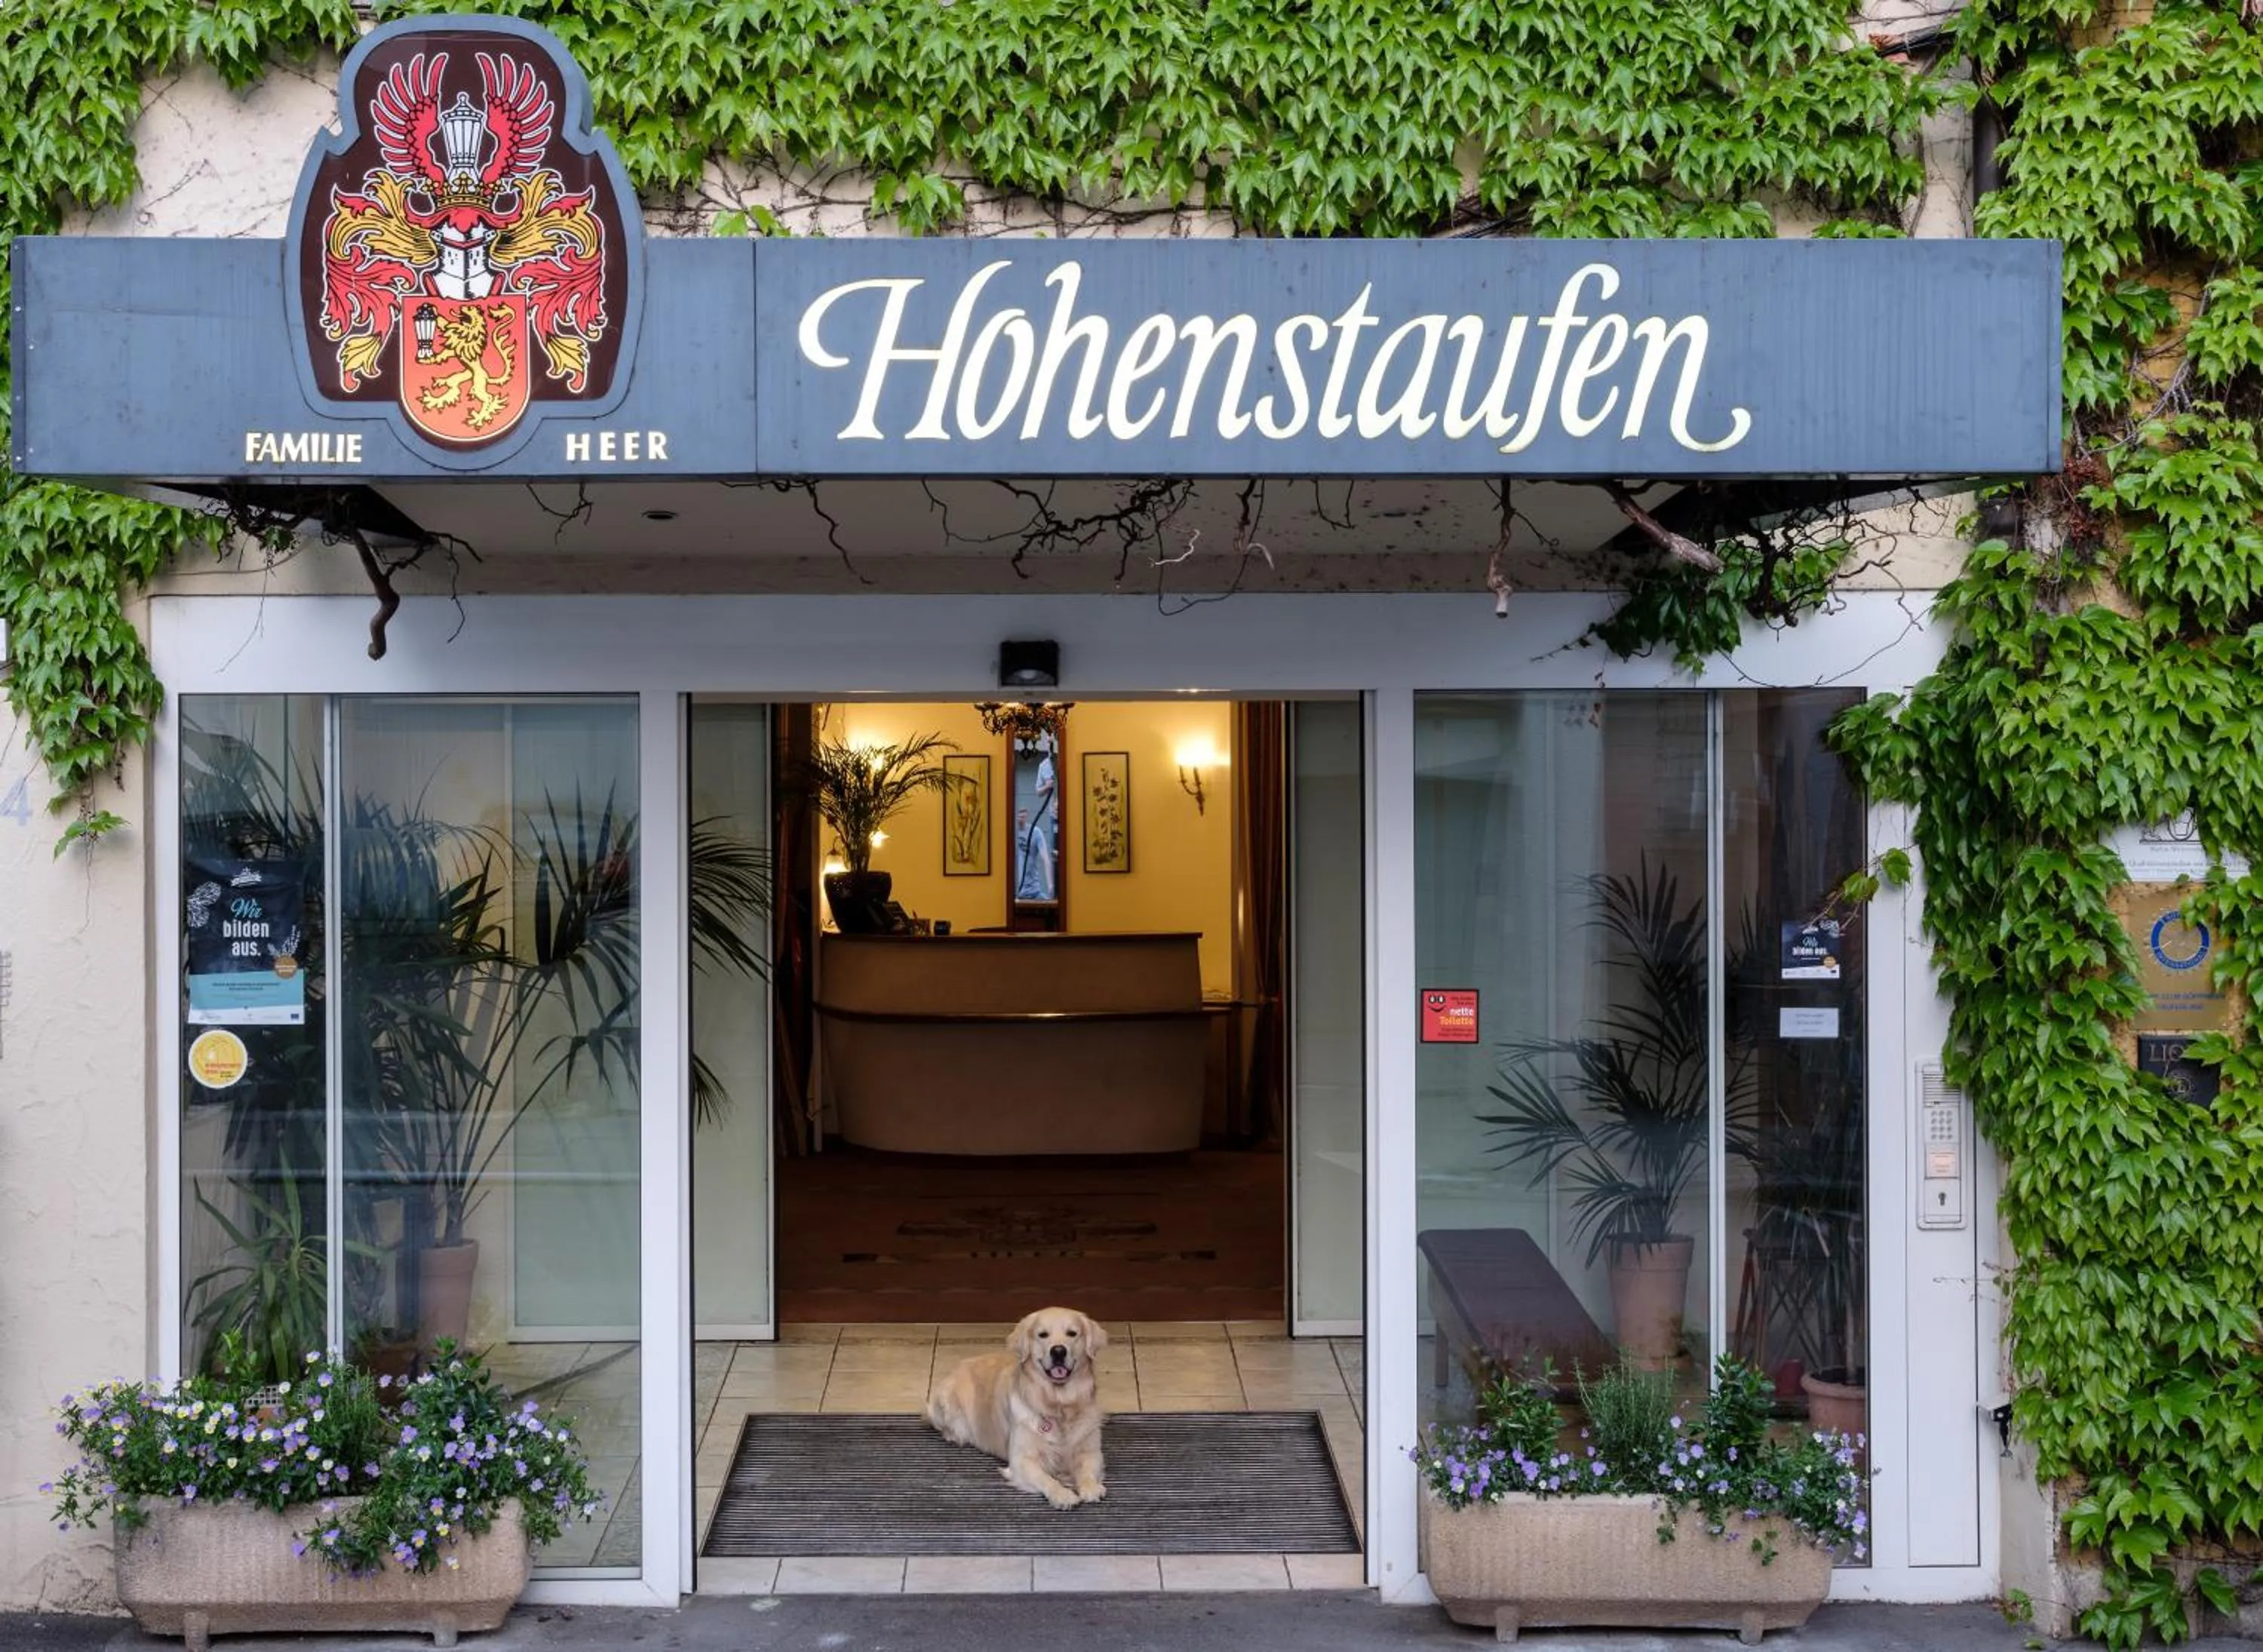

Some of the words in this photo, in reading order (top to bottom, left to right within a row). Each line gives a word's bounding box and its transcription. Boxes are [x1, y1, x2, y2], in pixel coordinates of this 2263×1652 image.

[799, 260, 1751, 453] Hohenstaufen
[245, 432, 362, 462] FAMILIE
[567, 431, 668, 461] HEER
[231, 898, 262, 918] Wir
[223, 920, 269, 938] bilden
[232, 941, 262, 957] aus.
[1449, 1007, 1473, 1016] nette
